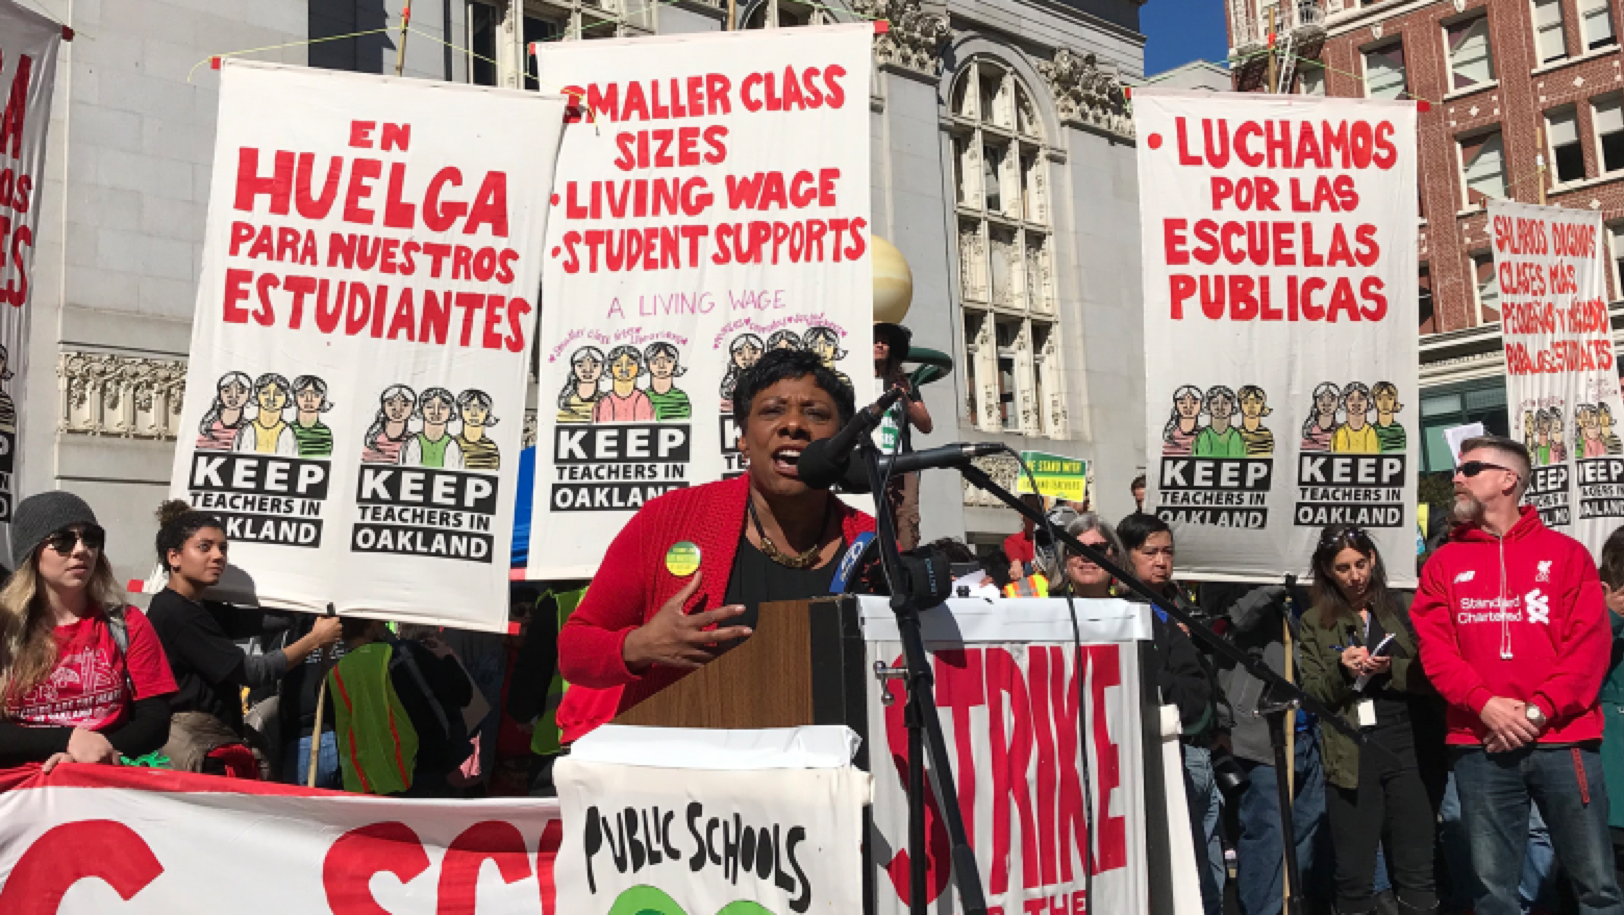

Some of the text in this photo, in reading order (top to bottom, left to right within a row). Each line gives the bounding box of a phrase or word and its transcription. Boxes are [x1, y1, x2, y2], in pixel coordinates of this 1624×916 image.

[740, 64, 847, 112] CLASS
[350, 121, 411, 151] EN
[614, 125, 729, 171] SIZES
[1175, 117, 1398, 169] LUCHAMOS
[233, 147, 509, 238] HUELGA
[566, 168, 841, 219] LIVING WAGE
[1211, 175, 1360, 212] POR LAS
[229, 222, 520, 284] PARA NUESTROS
[562, 216, 867, 273] STUDENT SUPPORTS
[1163, 218, 1380, 267] ESCUELAS
[223, 269, 532, 352] ESTUDIANTES
[606, 289, 786, 319] A LIVING WAGE
[1169, 273, 1388, 322] PUBLICAS
[558, 428, 686, 460] KEEP
[194, 455, 325, 491] KEEP
[556, 464, 685, 481] TEACHERS IN
[1162, 460, 1269, 488] KEEP
[1301, 456, 1402, 484] KEEP
[190, 491, 321, 516] TEACHERS IN
[361, 469, 493, 507] KEEP
[555, 486, 672, 509] OAKLAN
[1160, 491, 1266, 506] TEACHERS IN
[1300, 487, 1400, 501] TEACHERS IN
[214, 516, 317, 544] KLAND
[358, 506, 490, 531] TEACHERS IN
[1158, 509, 1263, 529] OAKLAND
[1298, 505, 1400, 525] OAKLAND
[356, 529, 488, 558] OAKLAND
[1458, 608, 1523, 625] Chartered
[1459, 594, 1521, 610] Standard
[884, 644, 1128, 908] STRIKE
[584, 801, 811, 914] PUBLIC SCHOOLS
